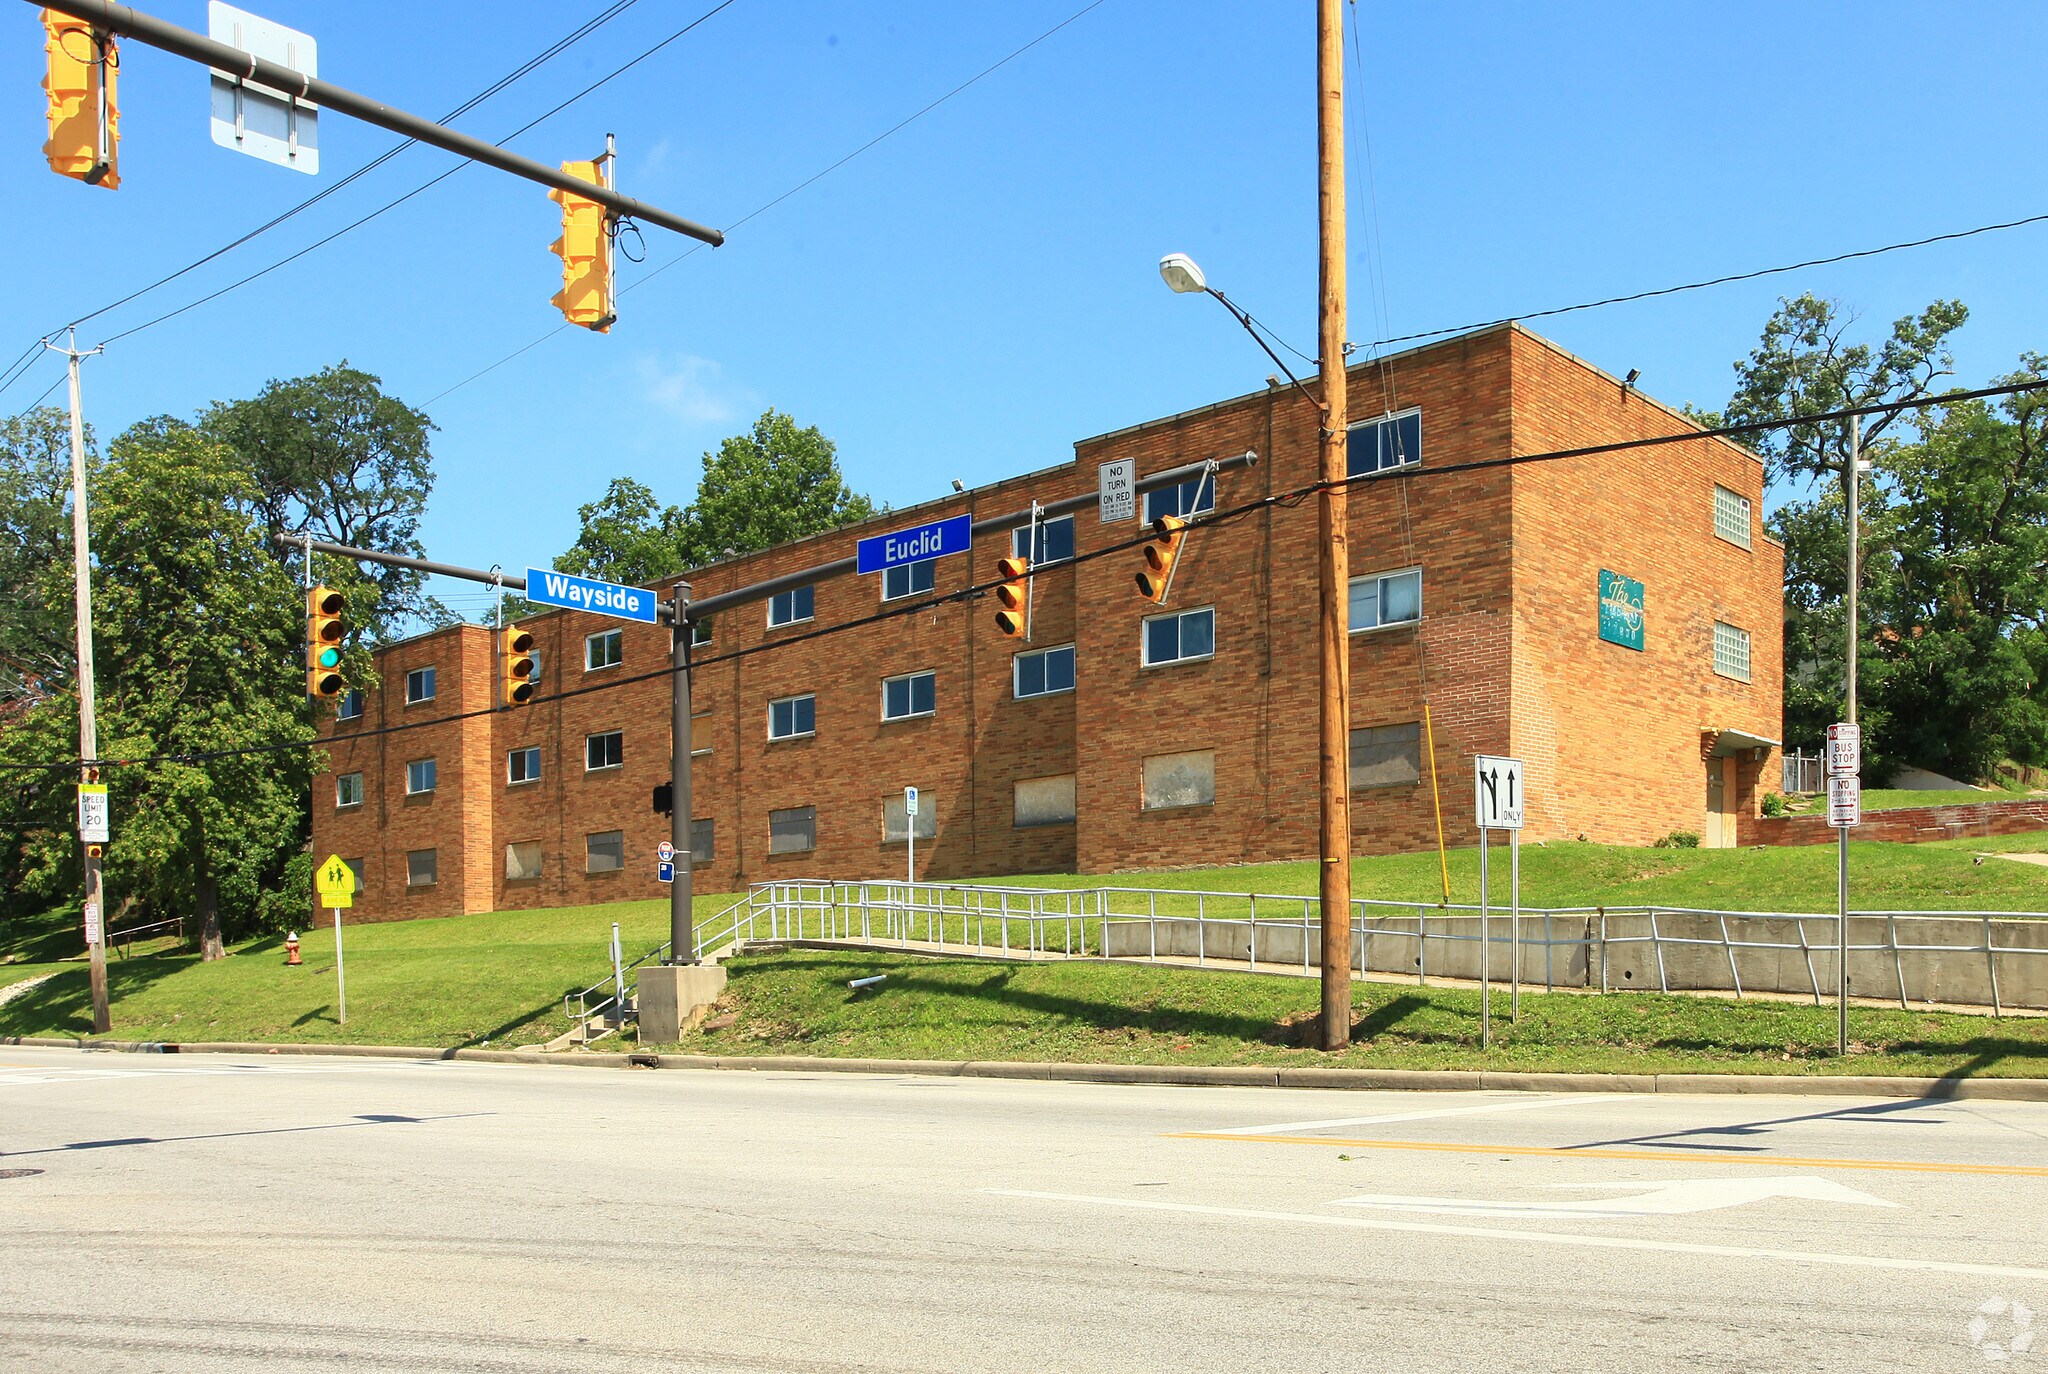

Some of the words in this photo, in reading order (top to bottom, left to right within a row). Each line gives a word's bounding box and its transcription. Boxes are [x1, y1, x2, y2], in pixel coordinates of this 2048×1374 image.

[1109, 466, 1123, 477] NO
[1107, 479, 1126, 490] TURN
[1103, 495, 1113, 504] ON
[1116, 491, 1130, 502] RED
[885, 527, 942, 563] Euclid
[544, 573, 640, 612] Wayside
[1609, 580, 1628, 604] The
[1829, 728, 1837, 738] NO
[1834, 743, 1852, 752] BUS
[1832, 753, 1855, 763] STOP
[1837, 780, 1849, 789] NO
[82, 795, 105, 803] SPEED
[84, 804, 102, 812] LIMIT
[86, 815, 101, 825] 20
[1503, 810, 1521, 822] ONLY
